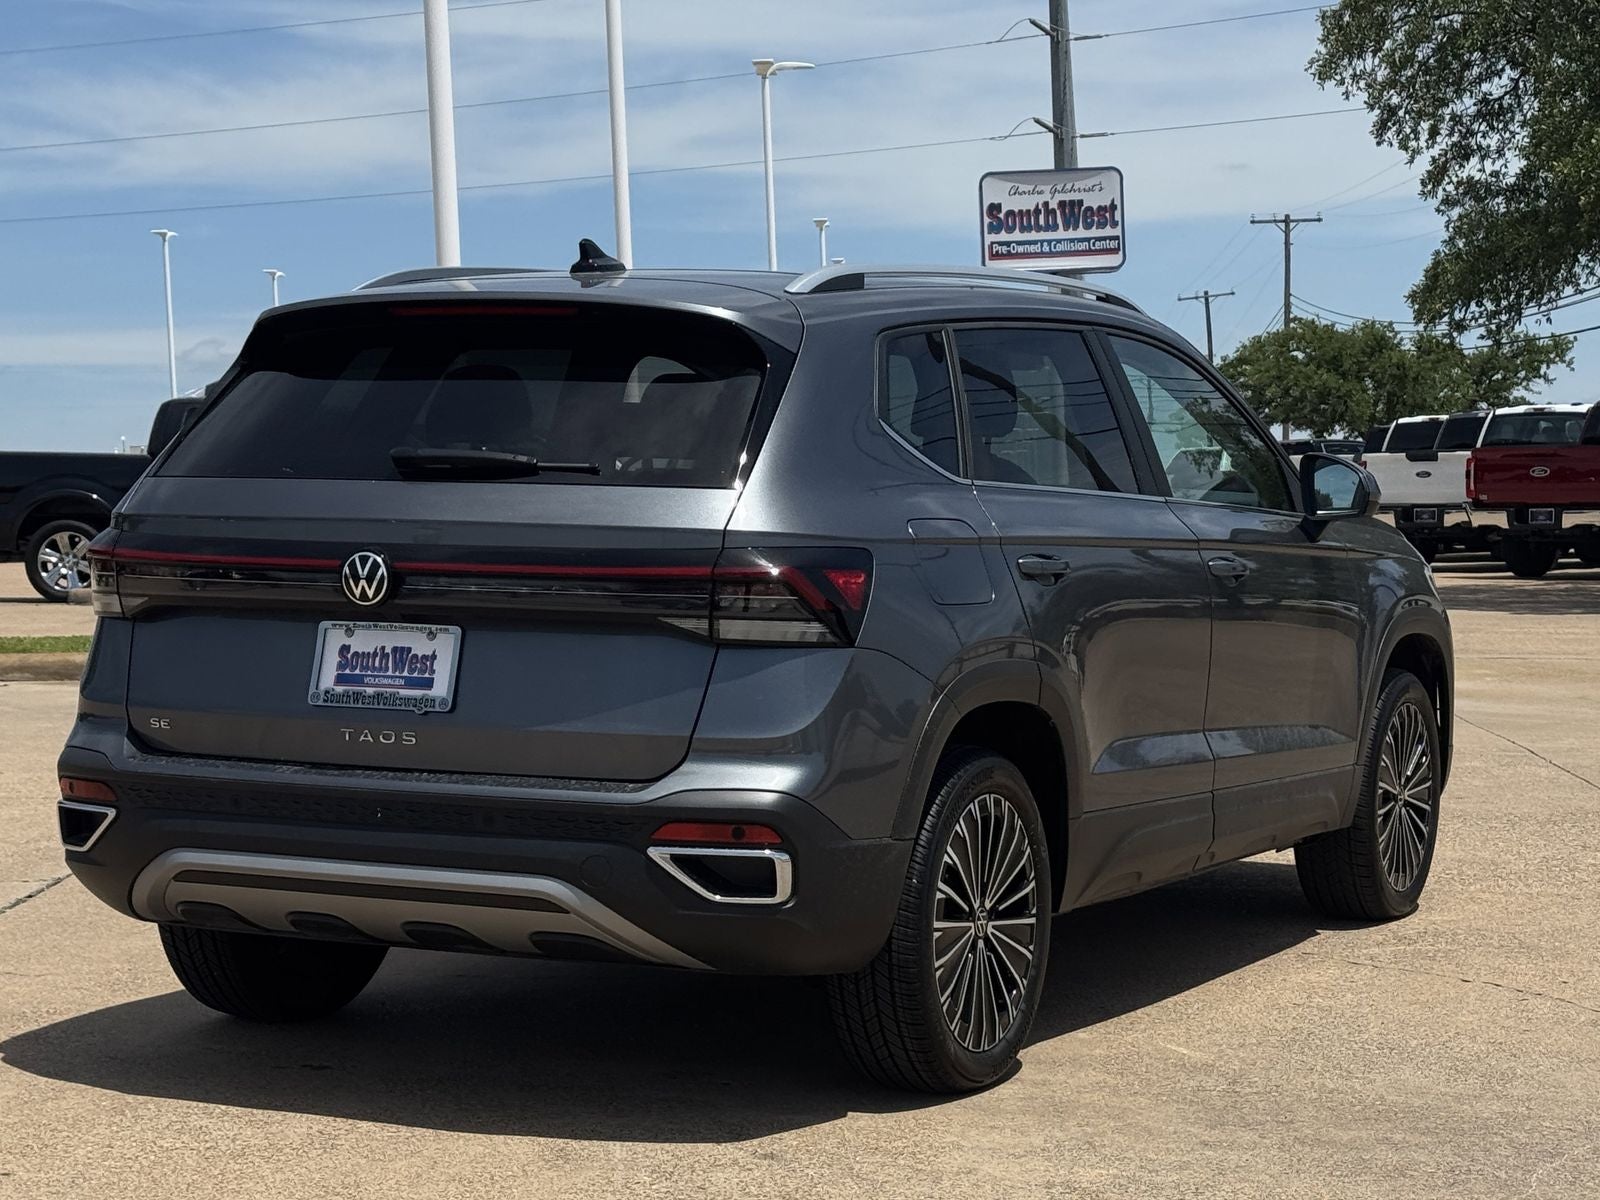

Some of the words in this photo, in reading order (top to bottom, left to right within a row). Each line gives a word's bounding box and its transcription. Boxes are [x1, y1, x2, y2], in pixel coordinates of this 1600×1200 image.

[1008, 184, 1045, 197] Charlie
[992, 242, 1041, 255] Pre-Owned
[1042, 241, 1050, 252] &
[1051, 240, 1089, 252] Collision
[1090, 239, 1119, 250] Center
[363, 677, 405, 686] VOLKSWAGEN
[150, 717, 171, 729] SE
[340, 728, 417, 745] TAOS
